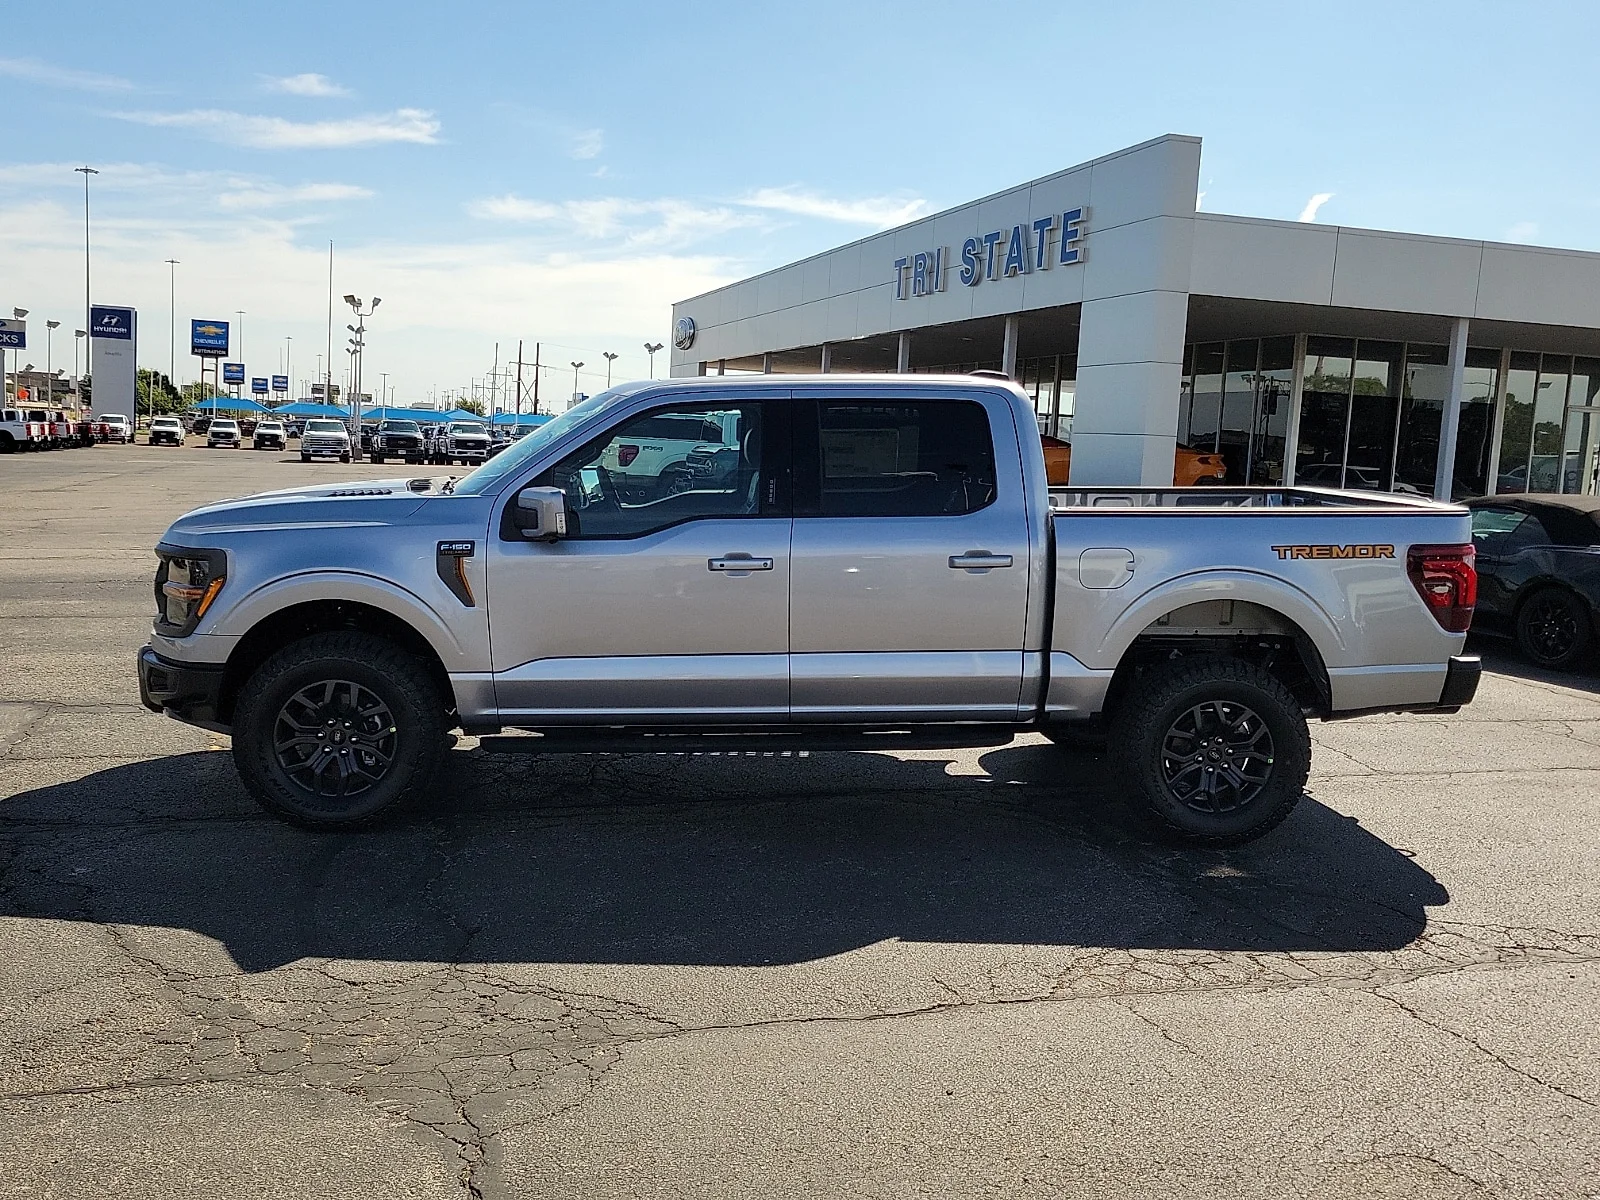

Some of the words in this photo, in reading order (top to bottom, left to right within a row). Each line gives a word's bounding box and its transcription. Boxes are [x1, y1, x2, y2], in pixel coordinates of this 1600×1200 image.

[893, 246, 947, 300] TRI
[959, 206, 1088, 287] STATE
[93, 326, 128, 334] HYUNDAI
[440, 543, 471, 551] F-150
[1271, 544, 1396, 560] TREMOR
